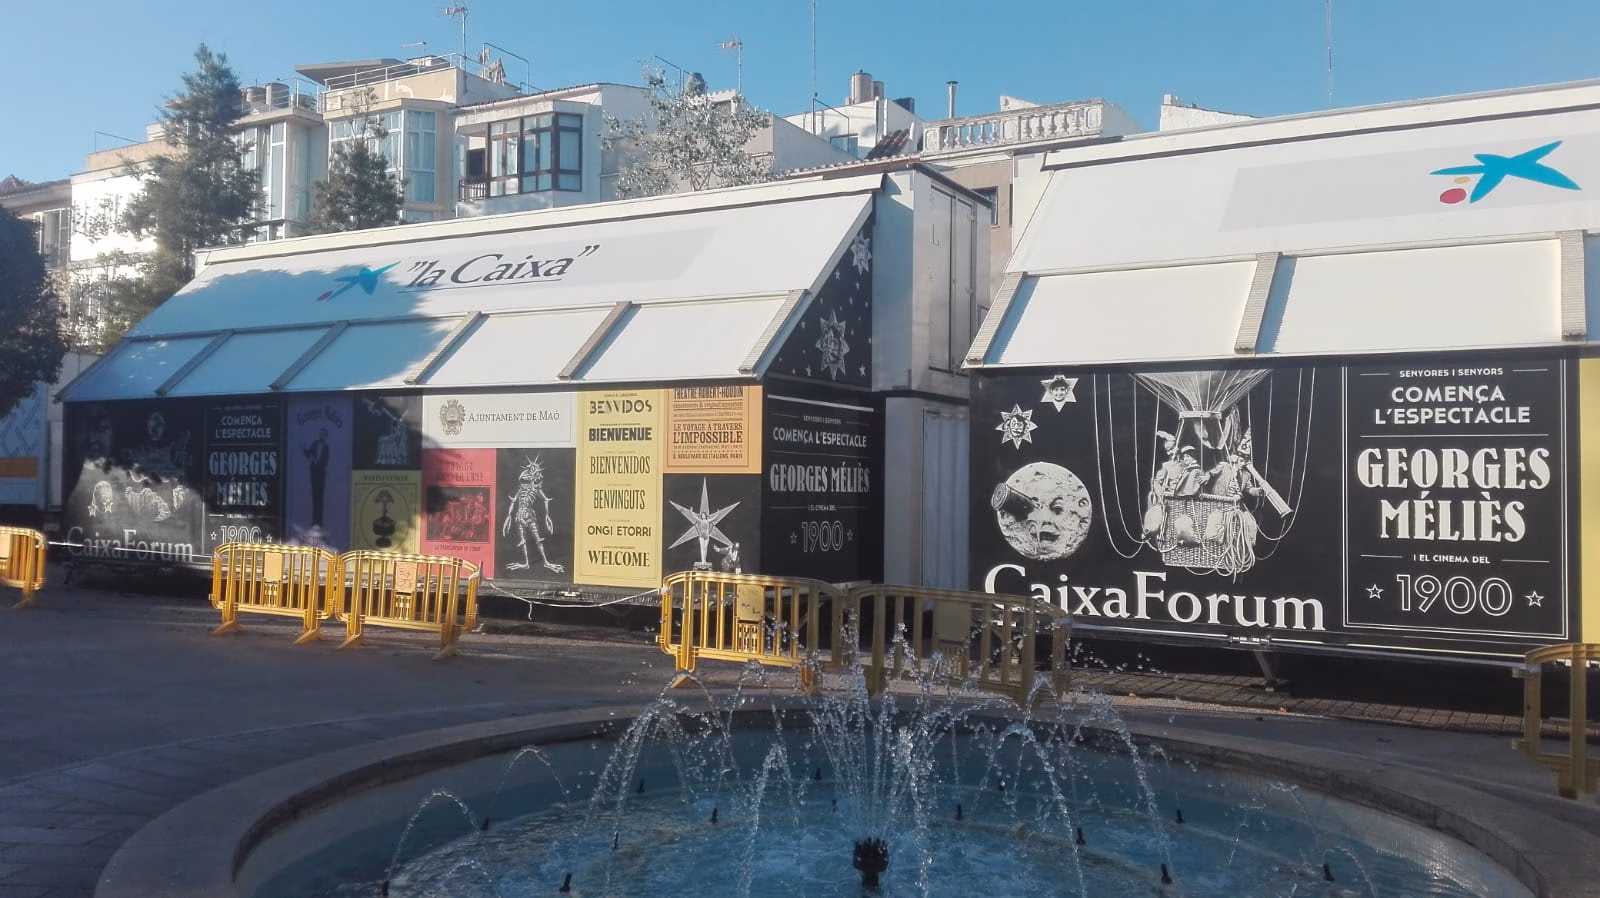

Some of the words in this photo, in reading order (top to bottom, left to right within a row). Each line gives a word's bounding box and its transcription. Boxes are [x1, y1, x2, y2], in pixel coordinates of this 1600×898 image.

[1400, 369, 1449, 378] SENYORES
[1452, 369, 1455, 377] I
[1458, 367, 1503, 376] SENYORS
[1391, 385, 1506, 404] COMENÇA
[589, 399, 653, 414] BENVIDOS
[1375, 406, 1531, 425] L'ESPECTACLE
[589, 427, 653, 442] BIENVENUE
[673, 423, 682, 431] LE
[683, 423, 706, 431] VOYAGE
[713, 422, 743, 431] TRAVERS
[673, 430, 743, 444] L'IMPOSSIBLE
[773, 427, 814, 444] COMENÇA
[815, 431, 867, 448] L'ESPECTACLE
[208, 451, 277, 476] GEORGES
[590, 455, 651, 474] BIENVENIDOS
[1356, 447, 1551, 490] GEORGES
[769, 463, 828, 492] GEORGES
[831, 461, 870, 493] MÉLIÈS
[593, 489, 646, 510] BENVINGUTS
[1380, 490, 1526, 543] MÉLIÈS
[221, 525, 262, 544] 1900
[587, 525, 613, 536] ONGI
[616, 526, 651, 537] ETORRI
[801, 520, 844, 552] 1900
[66, 526, 193, 563] CaixaForum
[588, 550, 650, 567] WELCOME
[1419, 554, 1431, 562] EL
[1433, 555, 1469, 563] CINEMA
[1472, 555, 1491, 564] DEL
[984, 563, 1326, 631] CaixaForum
[1396, 574, 1512, 616] 1900
